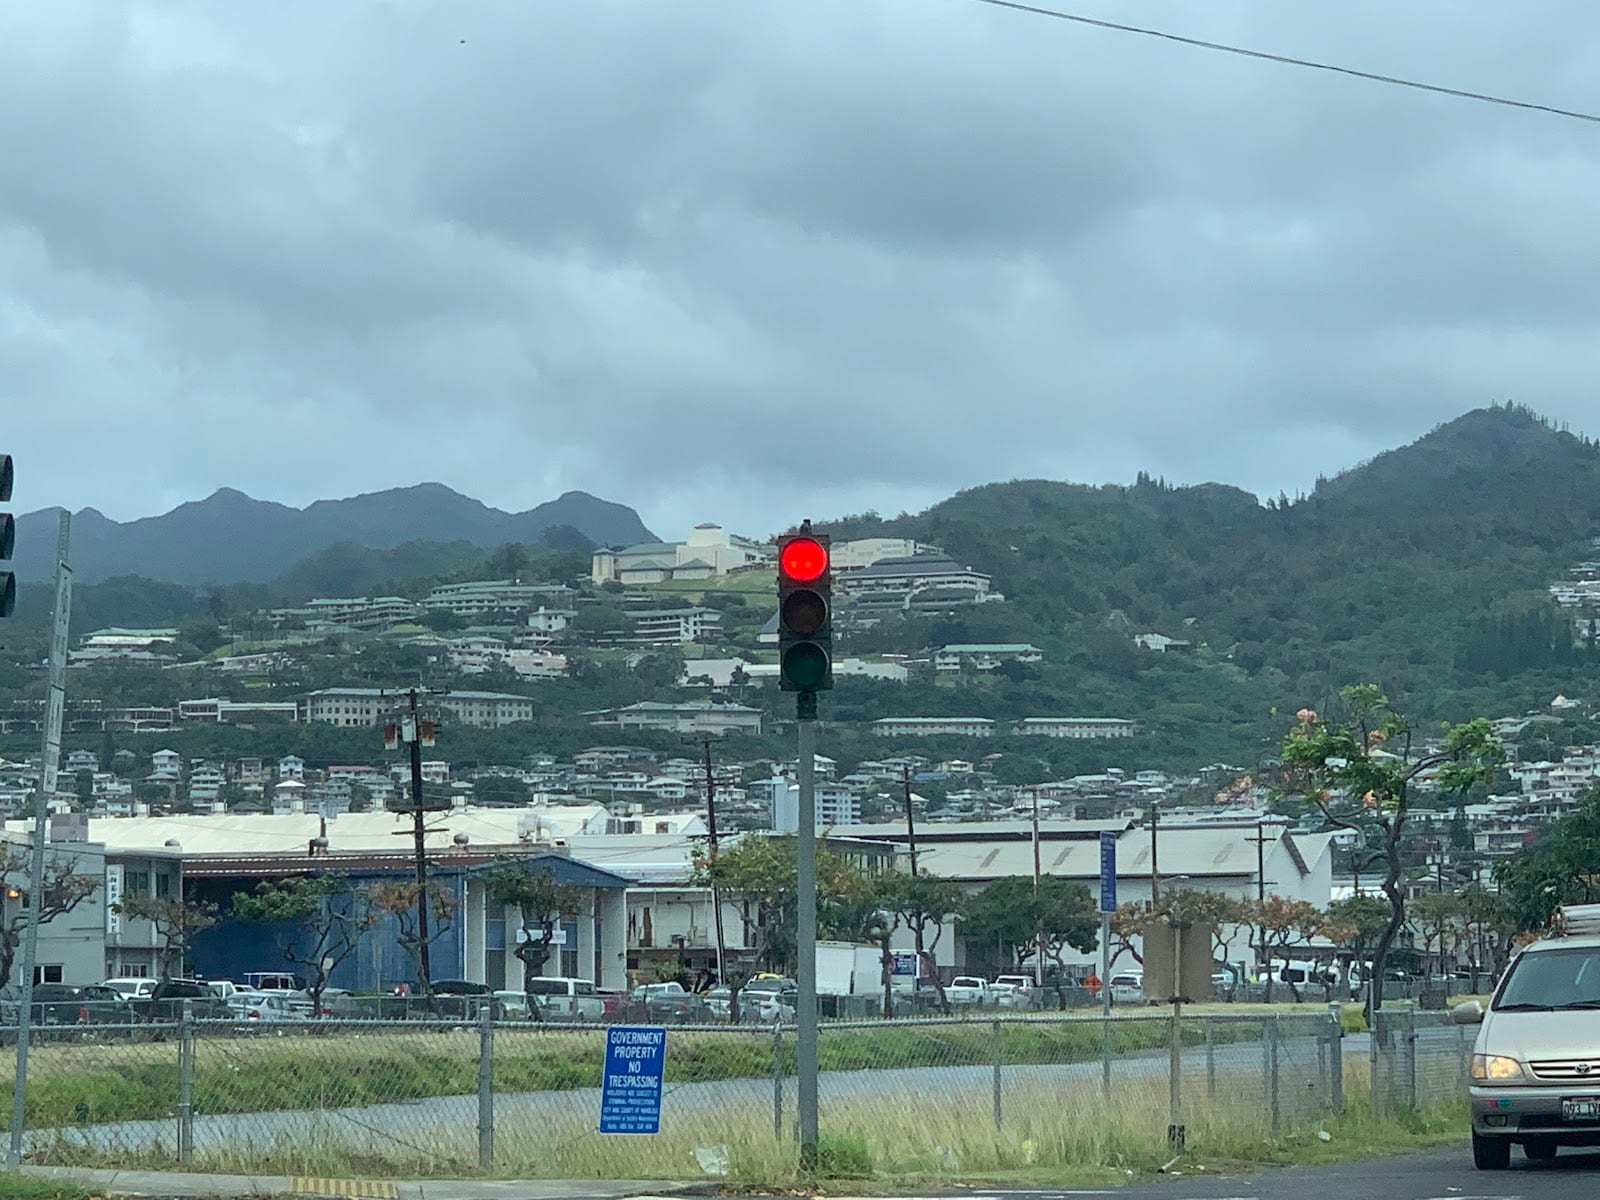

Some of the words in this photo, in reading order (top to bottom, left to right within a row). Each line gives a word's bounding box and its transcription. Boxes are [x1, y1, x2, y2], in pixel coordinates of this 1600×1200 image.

[610, 1031, 663, 1045] GOVERNMENT
[614, 1045, 658, 1059] PROPERTY
[628, 1060, 641, 1074] NO
[609, 1074, 658, 1089] TRESPASSING
